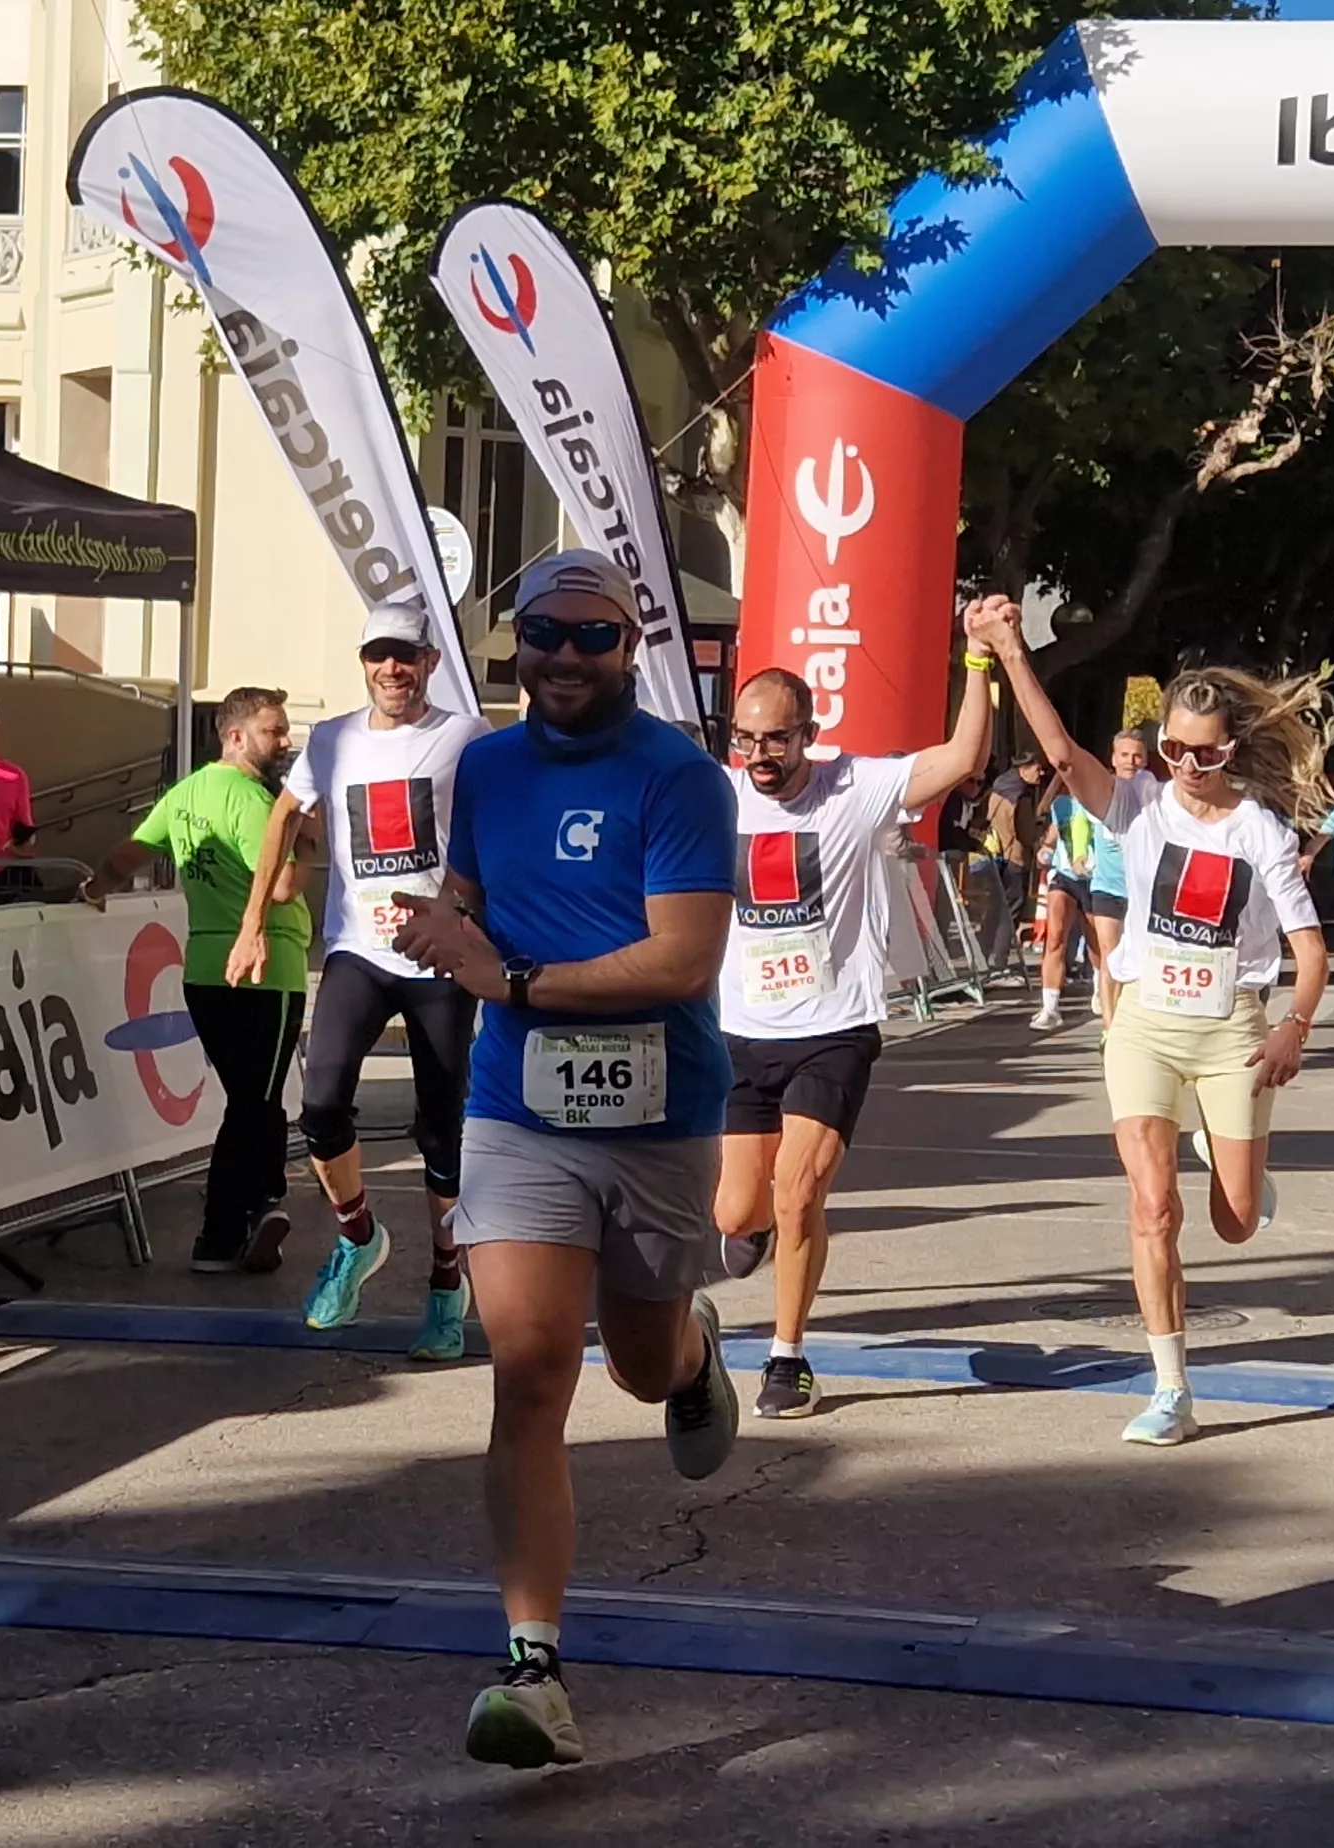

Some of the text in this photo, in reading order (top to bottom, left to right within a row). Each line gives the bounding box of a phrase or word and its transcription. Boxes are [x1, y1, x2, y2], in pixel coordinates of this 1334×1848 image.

[373, 904, 407, 926] 52
[761, 955, 810, 979] 518
[1162, 965, 1213, 988] 519
[761, 976, 815, 992] ALBERTO
[556, 1059, 632, 1090] 146
[564, 1094, 625, 1107] PEDRO
[565, 1108, 592, 1124] 8K
